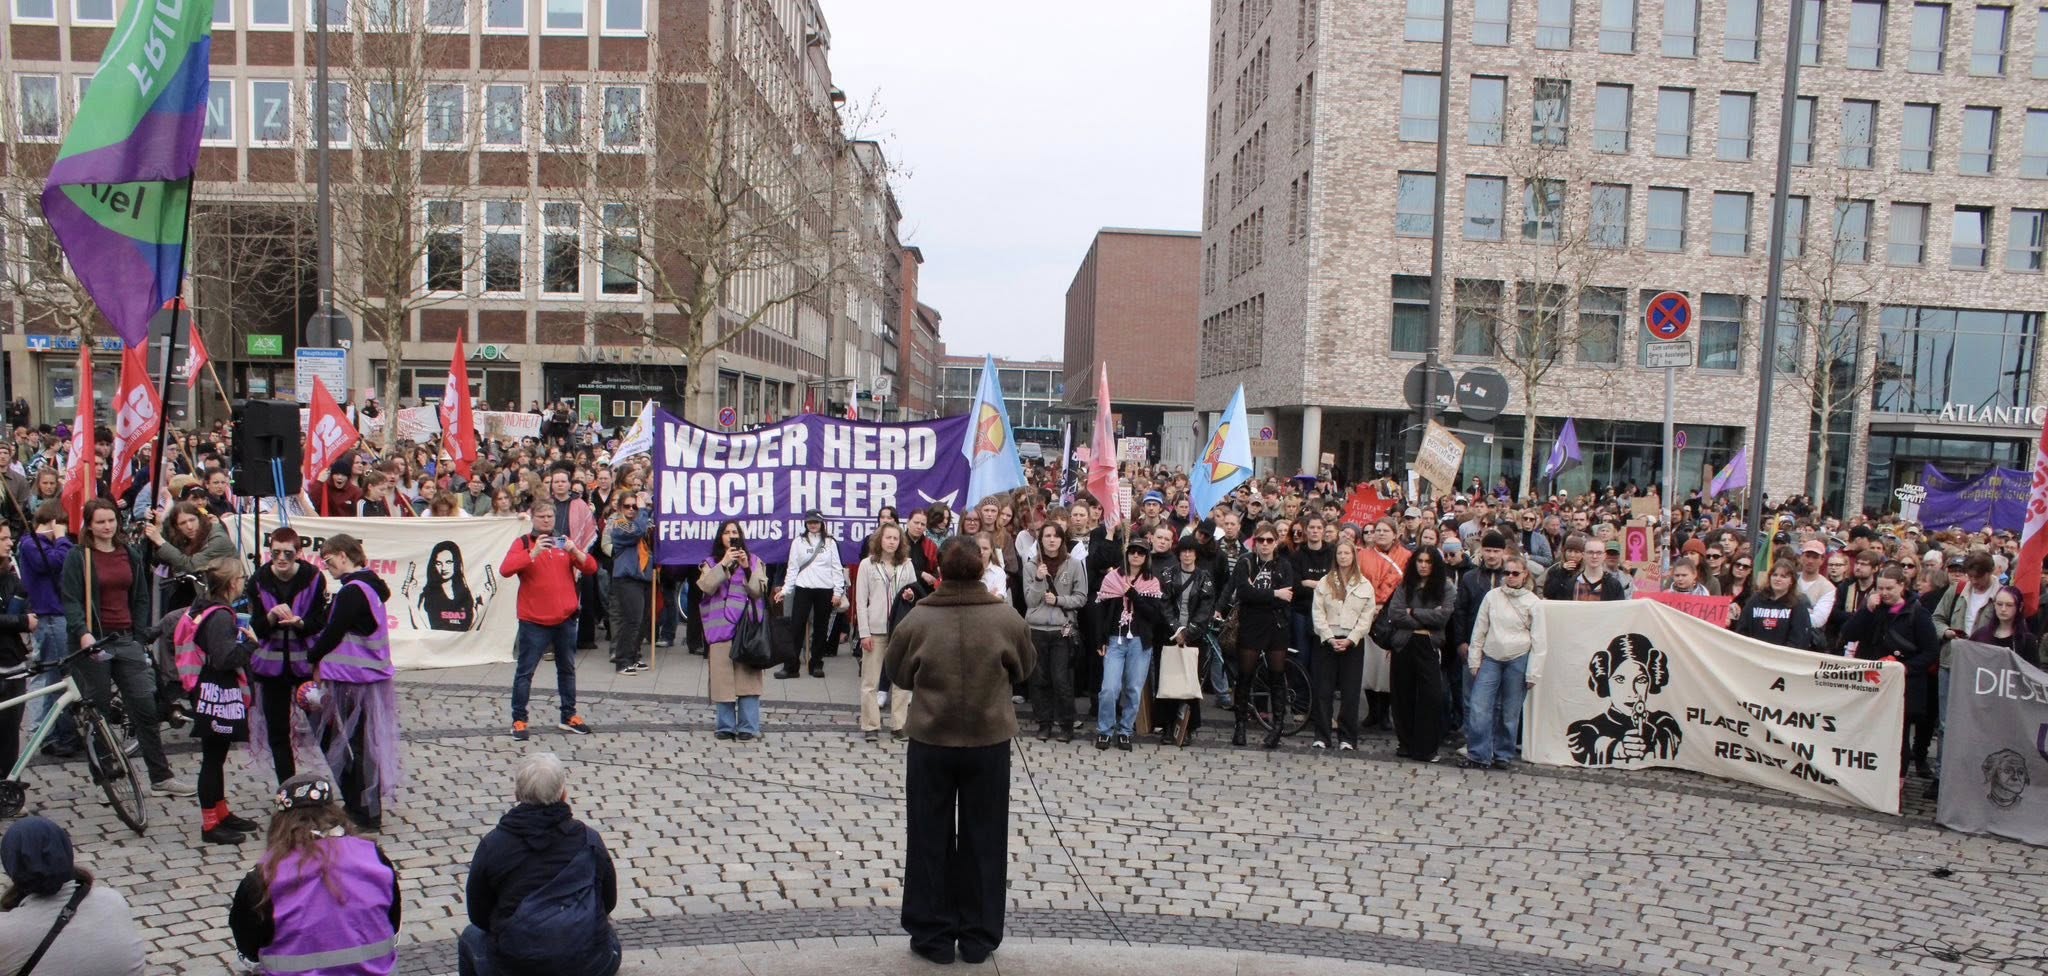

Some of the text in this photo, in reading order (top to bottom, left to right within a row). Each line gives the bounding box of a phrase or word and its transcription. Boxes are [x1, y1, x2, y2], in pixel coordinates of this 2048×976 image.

[254, 338, 277, 347] AOK
[470, 344, 510, 360] AOK
[1939, 401, 2048, 425] ATLANTIC
[664, 422, 937, 470] WEDER HERD
[660, 470, 898, 517] NOCH HEER
[200, 682, 219, 703] THIS
[1769, 677, 1785, 692] A
[196, 700, 246, 720] IS A FEMINIST
[1686, 706, 1750, 737] PLACE
[1832, 747, 1879, 771] THE
